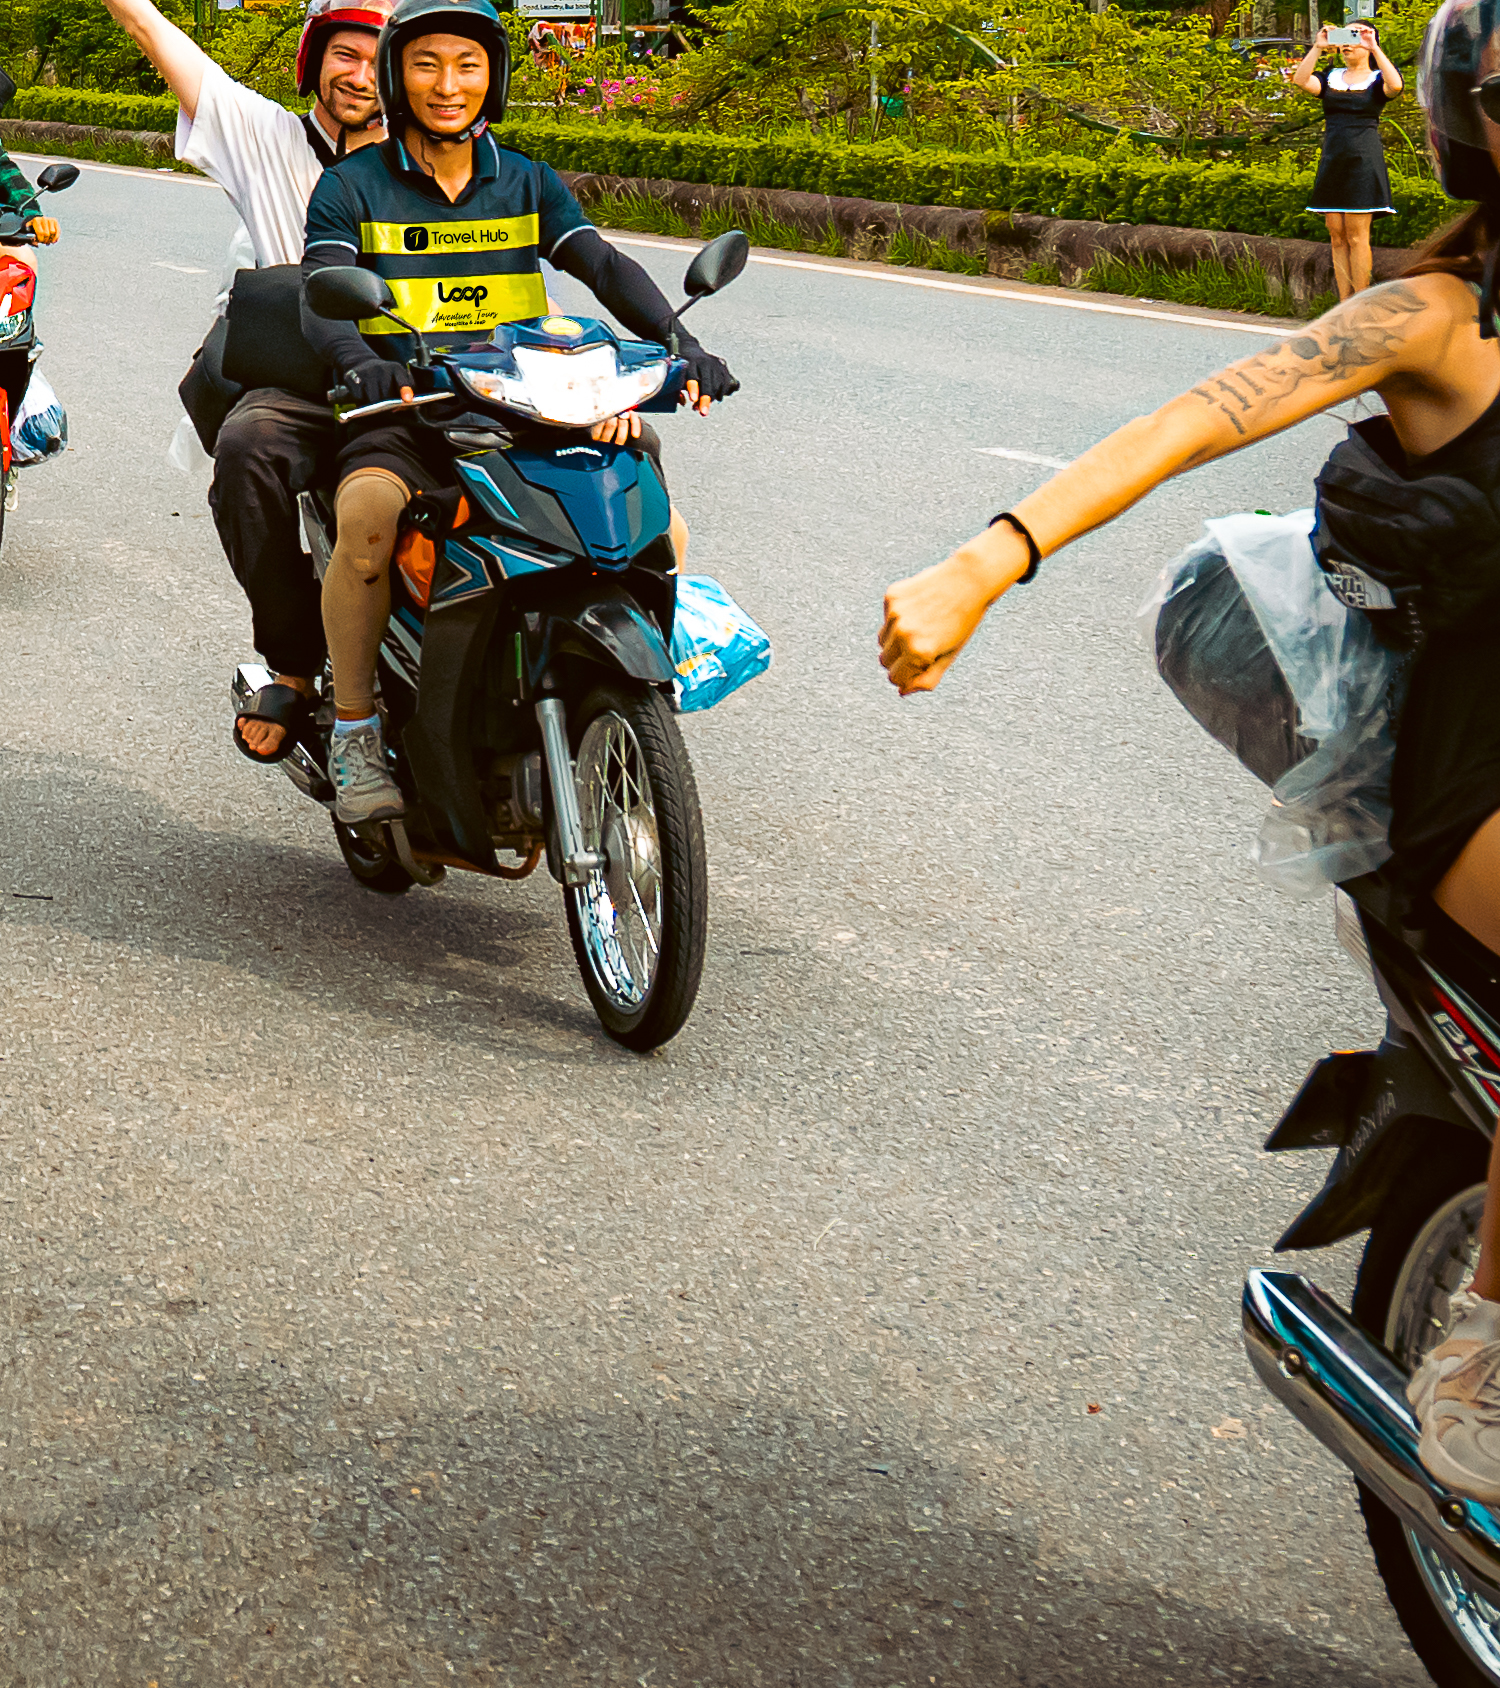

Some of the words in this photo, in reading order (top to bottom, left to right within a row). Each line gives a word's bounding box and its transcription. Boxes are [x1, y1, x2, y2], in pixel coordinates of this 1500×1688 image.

[431, 230, 478, 245] Travel
[480, 229, 509, 243] Hub
[437, 281, 489, 307] Loop
[431, 312, 473, 324] Adventure
[474, 308, 499, 319] Tours
